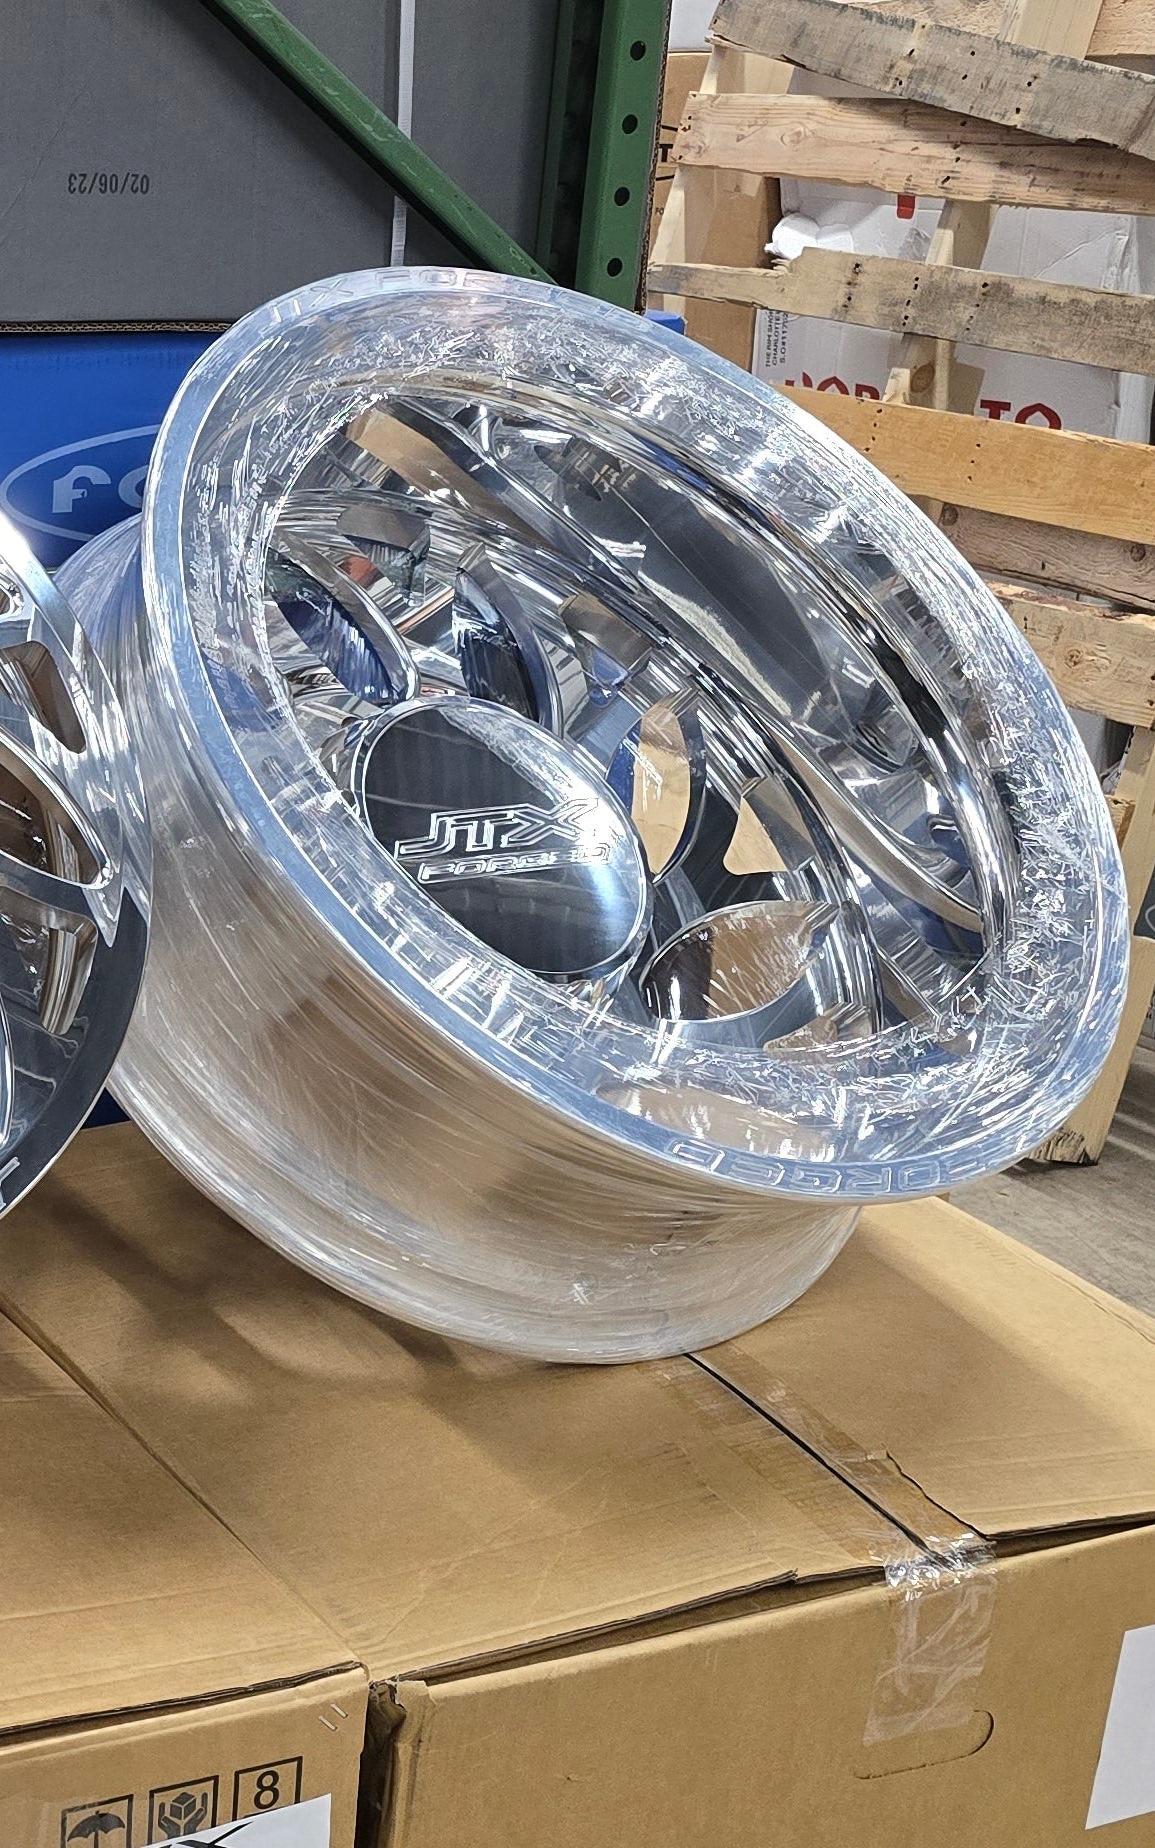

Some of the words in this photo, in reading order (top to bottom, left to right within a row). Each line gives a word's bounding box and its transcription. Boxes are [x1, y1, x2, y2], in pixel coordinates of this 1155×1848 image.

[67, 172, 151, 195] 02/06/23
[394, 797, 600, 861] JTX
[252, 1769, 280, 1809] 8
